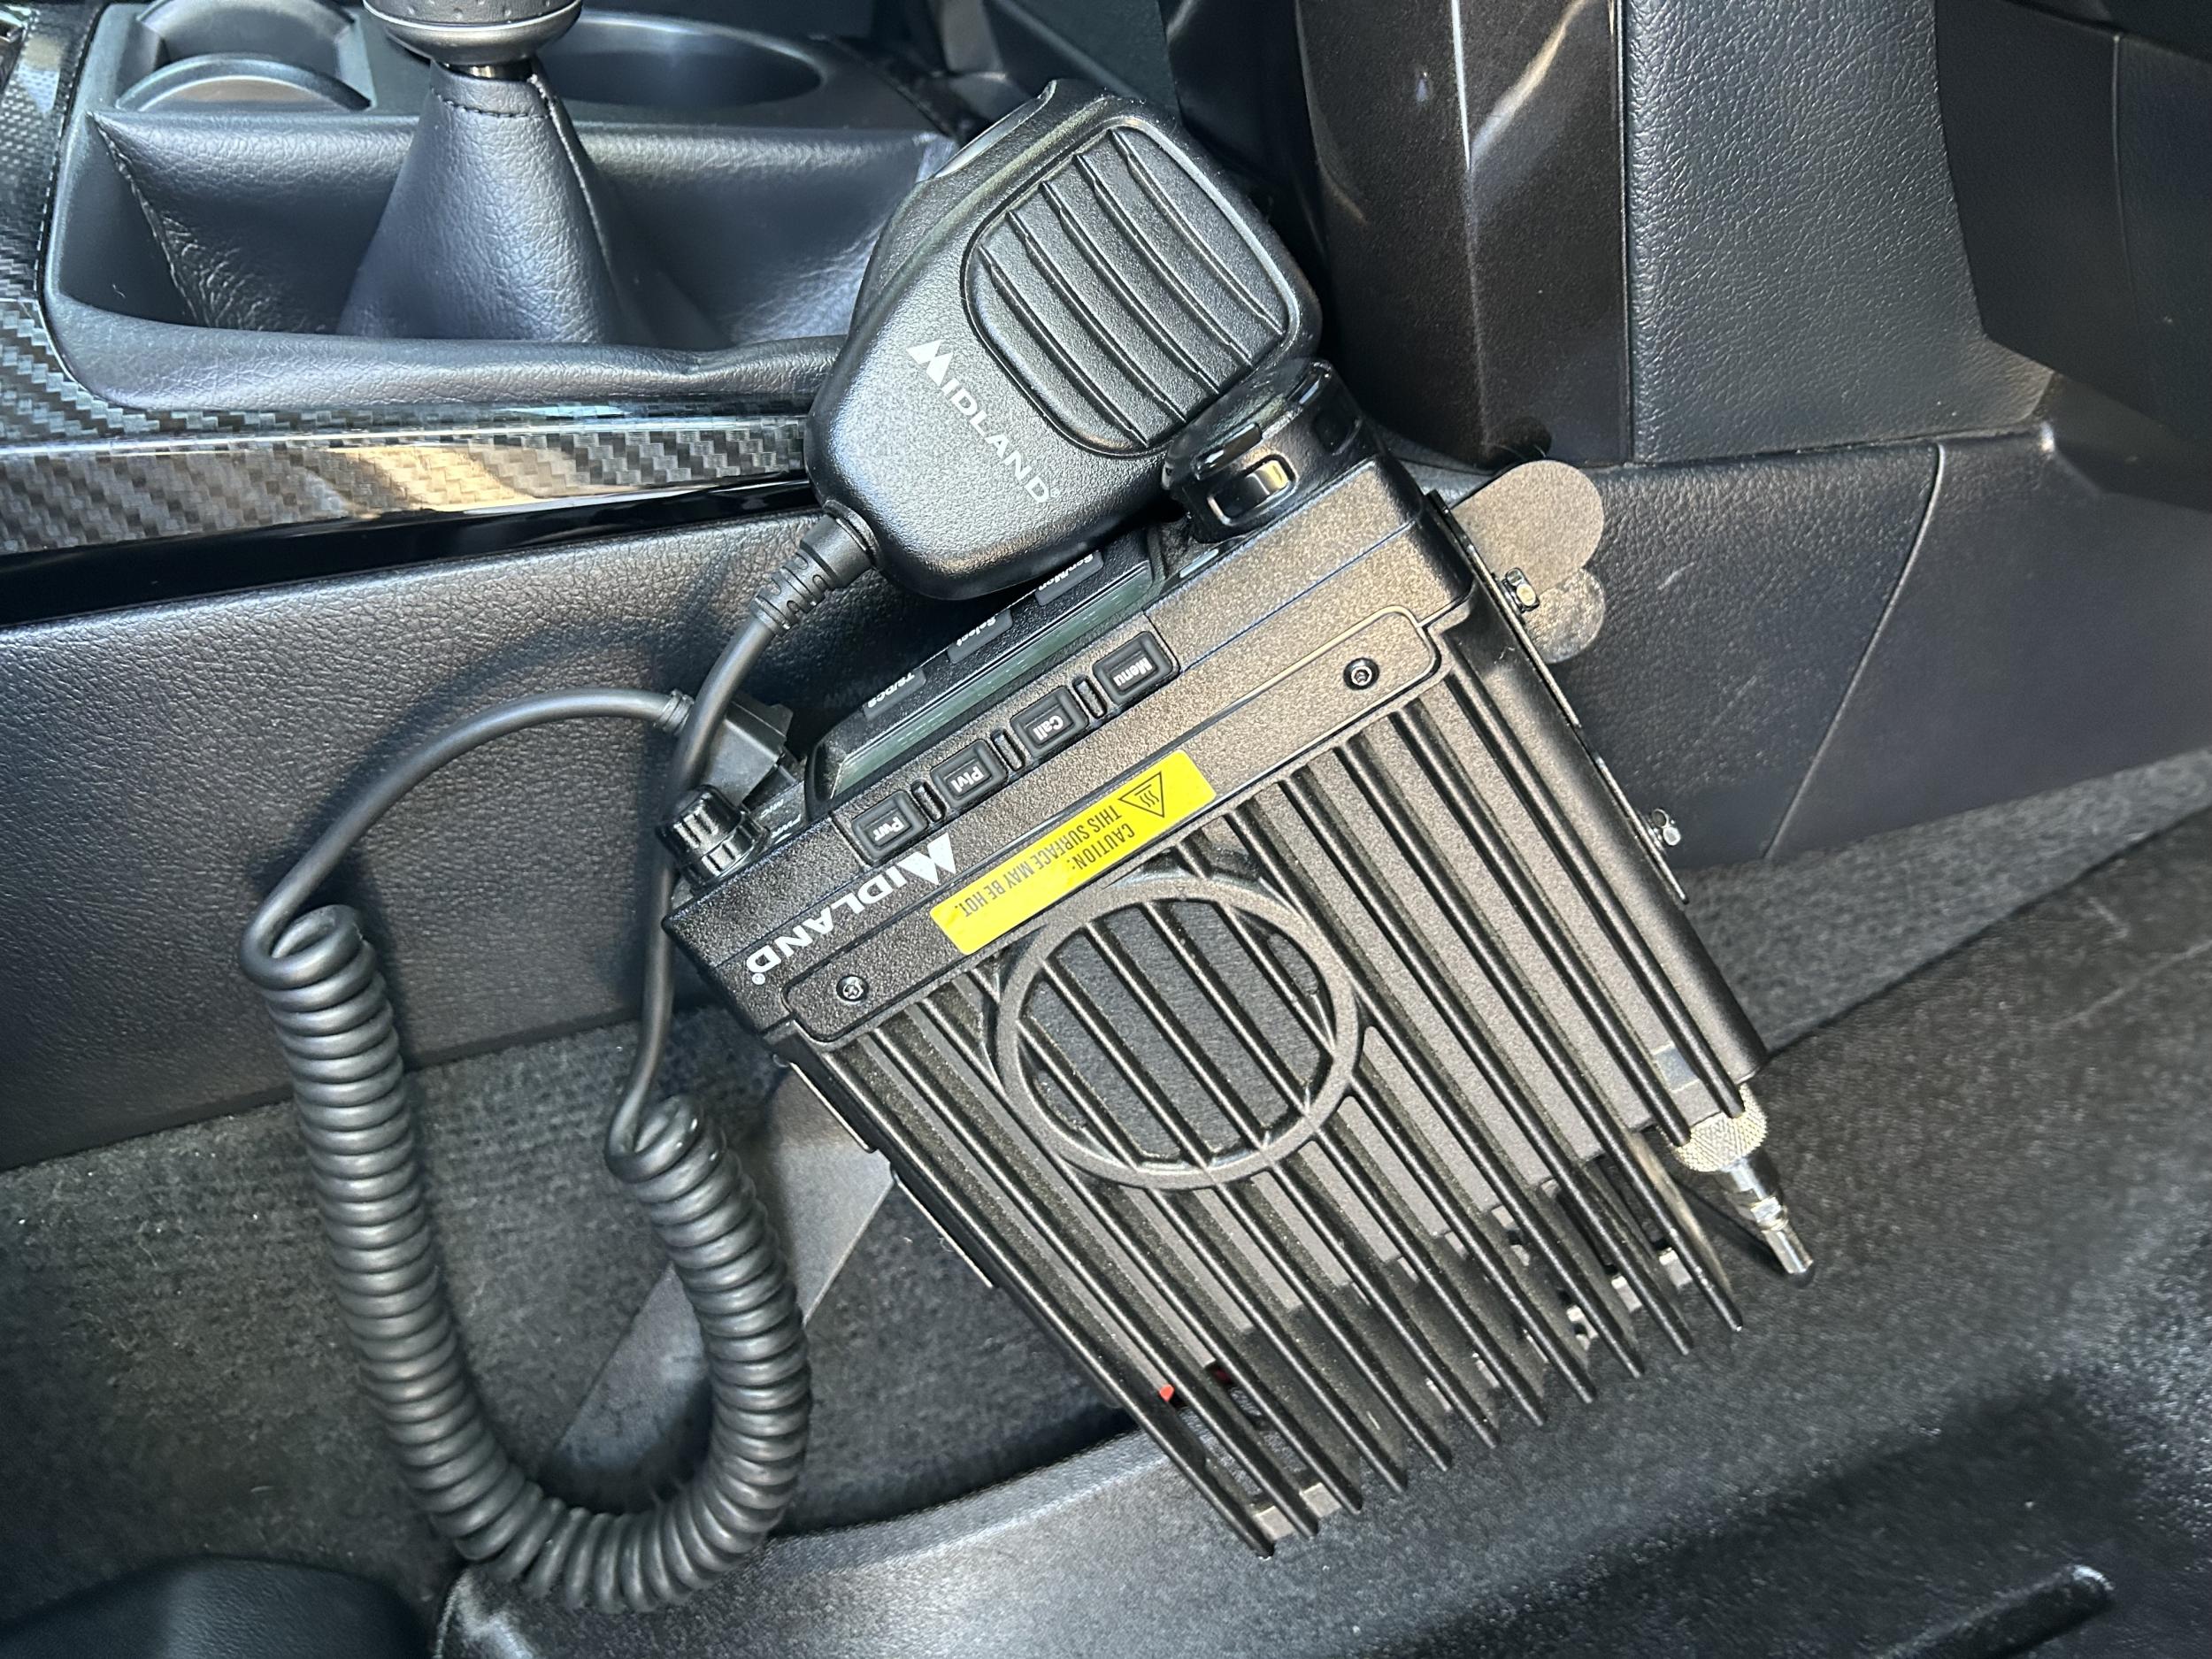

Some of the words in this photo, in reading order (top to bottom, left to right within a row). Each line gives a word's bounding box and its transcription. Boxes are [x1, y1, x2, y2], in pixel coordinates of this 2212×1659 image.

[906, 339, 1050, 503] MIDLAND
[956, 616, 996, 647] Select
[1113, 657, 1153, 687] Menu
[1033, 716, 1064, 741] Call
[872, 817, 905, 841] Pwr
[1087, 805, 1122, 833] THIS
[1030, 825, 1090, 870] SURFACE
[1067, 824, 1135, 870] CAUTION:
[984, 879, 1006, 900] BE
[1003, 861, 1035, 889] MAY
[746, 833, 956, 973] MIDLAND
[955, 891, 988, 918] HOT.
